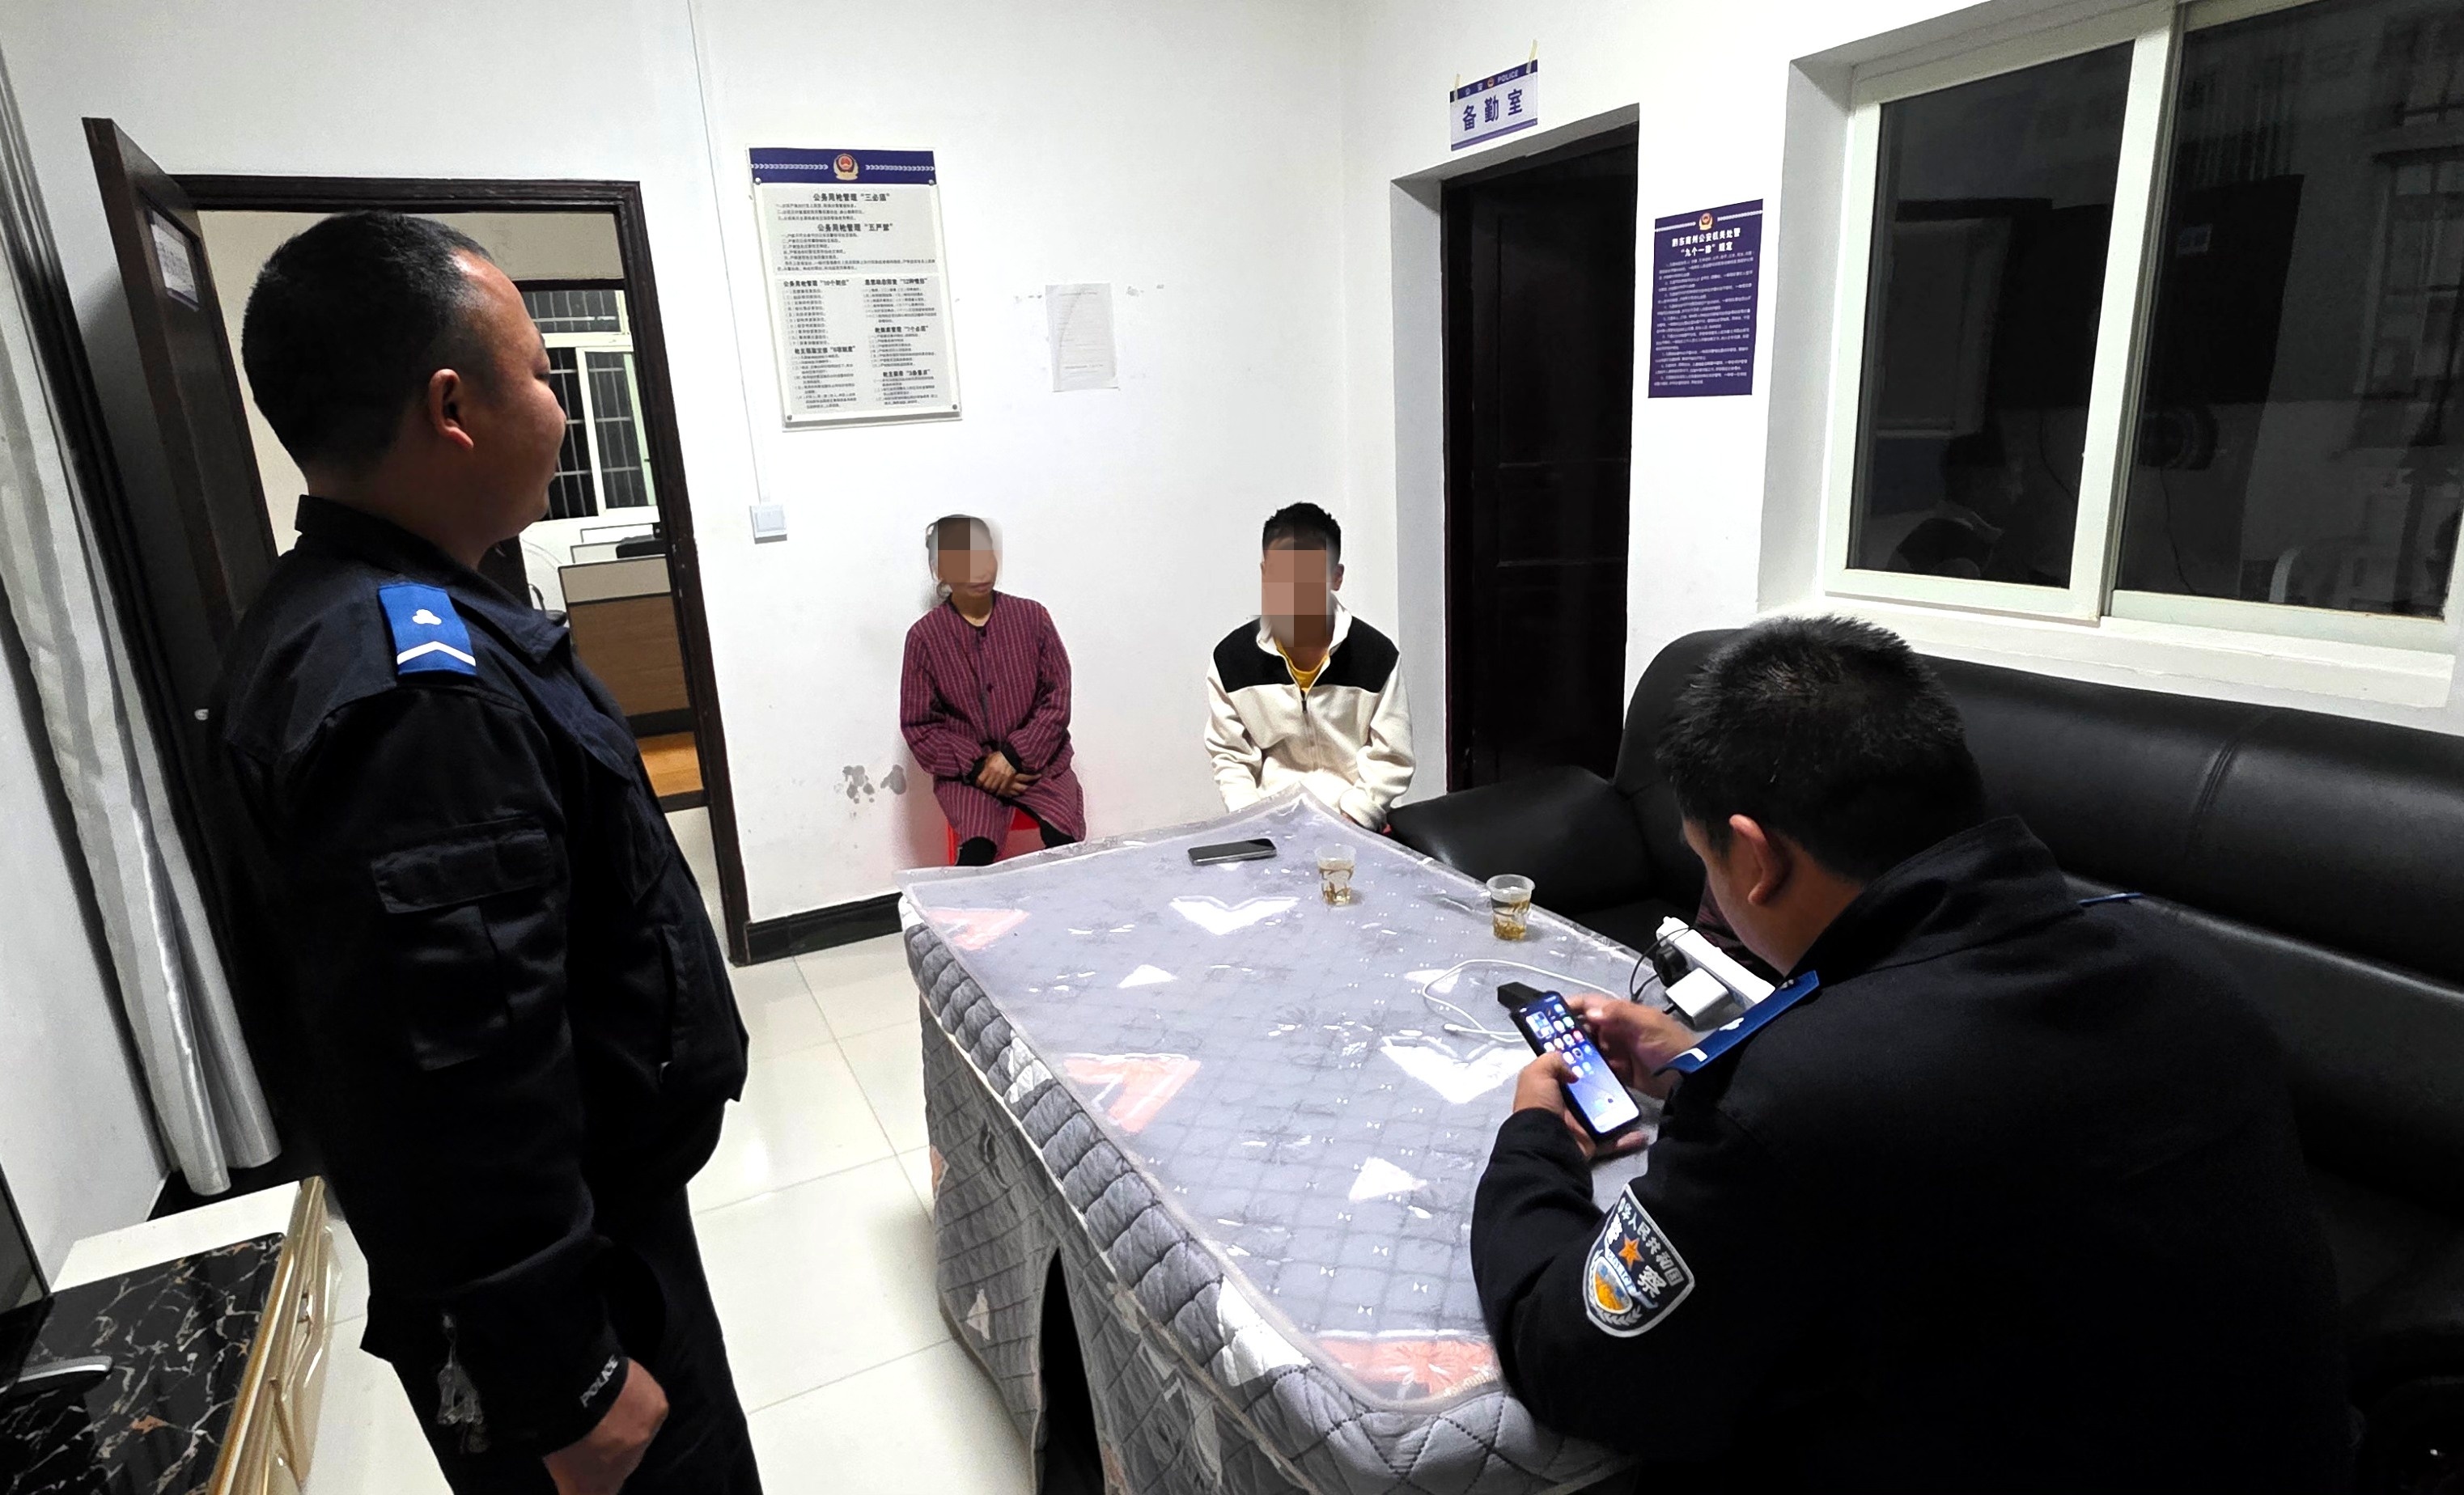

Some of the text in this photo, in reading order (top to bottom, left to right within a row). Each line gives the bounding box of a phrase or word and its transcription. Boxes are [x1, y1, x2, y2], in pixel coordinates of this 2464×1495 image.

[1497, 70, 1519, 83] POLICE
[1462, 88, 1523, 131] 备勤室
